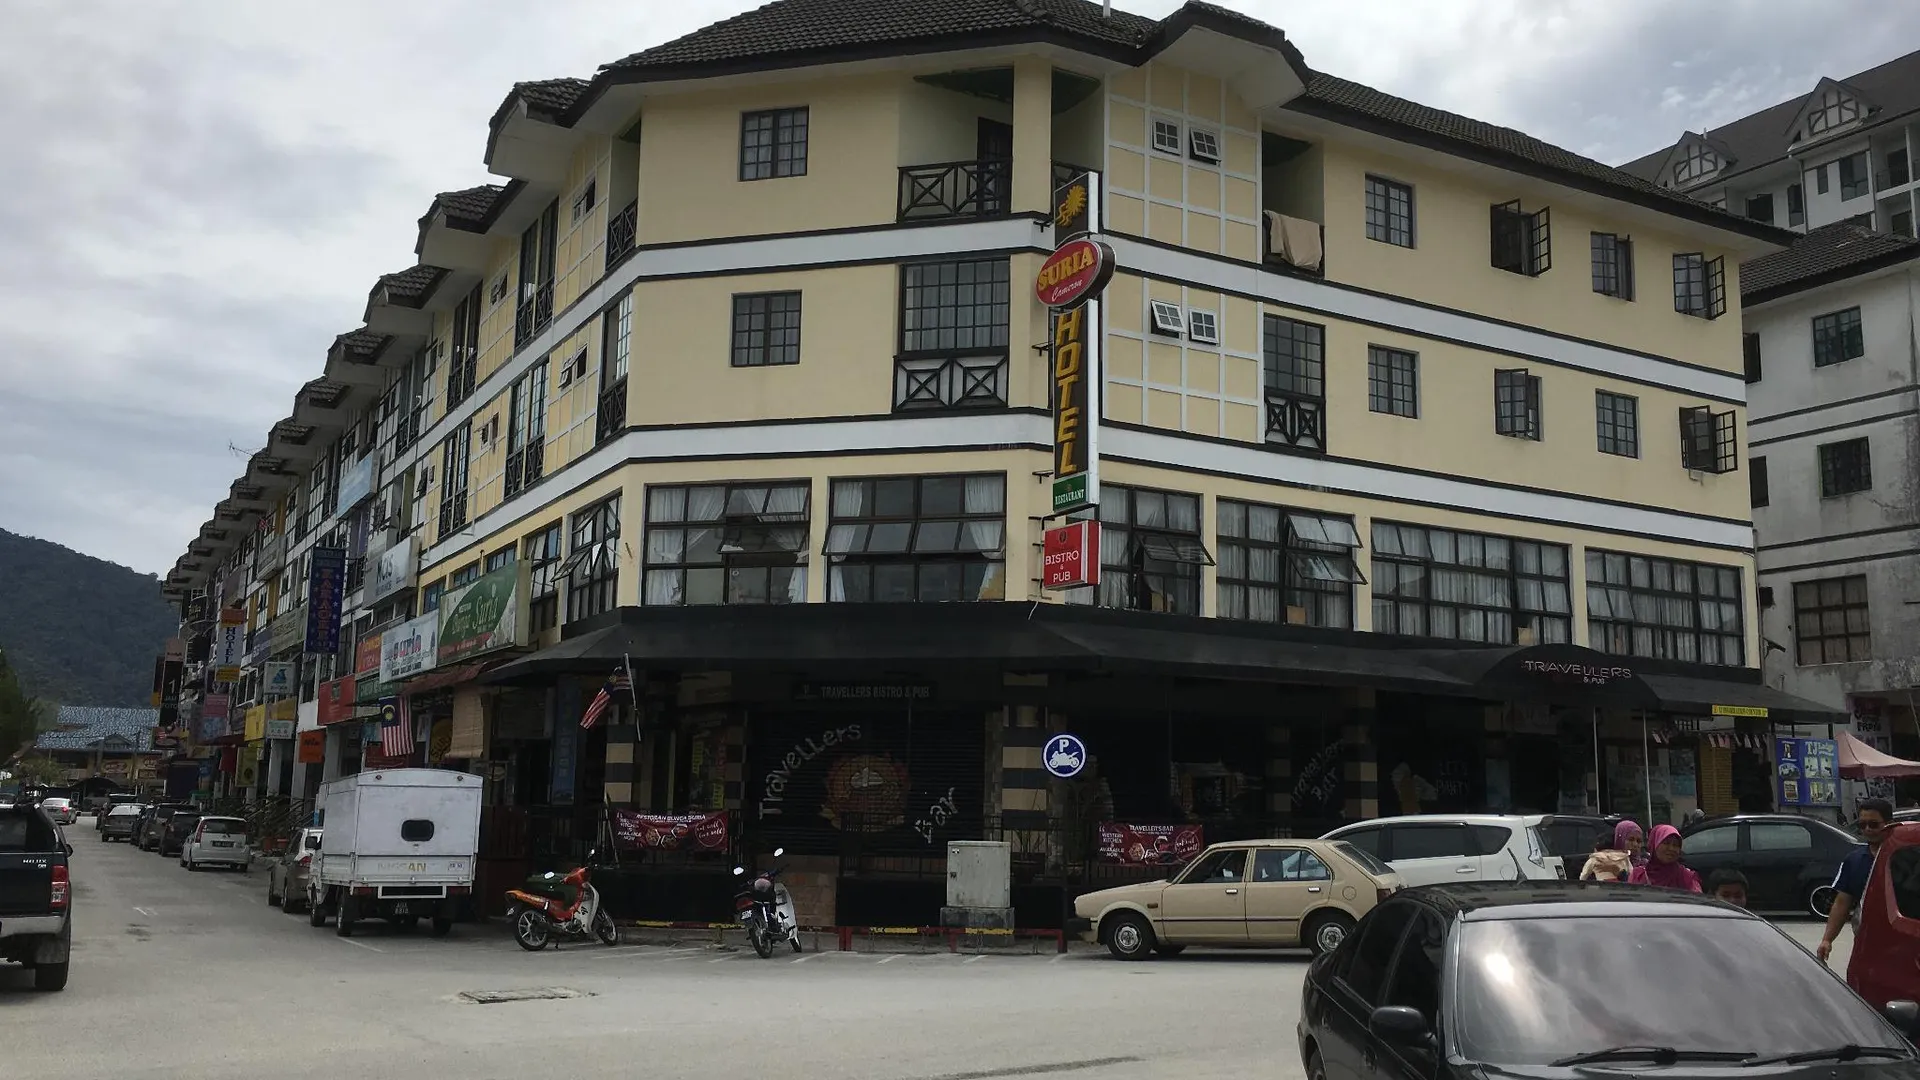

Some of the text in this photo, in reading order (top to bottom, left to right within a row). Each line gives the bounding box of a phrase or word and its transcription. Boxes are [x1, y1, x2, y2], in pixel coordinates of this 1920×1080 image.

[1038, 246, 1095, 291] SURIA
[1056, 309, 1082, 475] HOTEL
[1055, 488, 1085, 506] RESTAURANT
[1045, 550, 1080, 566] BISTRO
[1053, 570, 1071, 583] PUB
[225, 627, 236, 664] HOTEL
[1524, 660, 1632, 679] TRAVELLERS
[820, 685, 872, 699] TRAVELLERS
[873, 686, 903, 698] BISTRO
[912, 686, 930, 698] PUB
[1059, 739, 1070, 752] P
